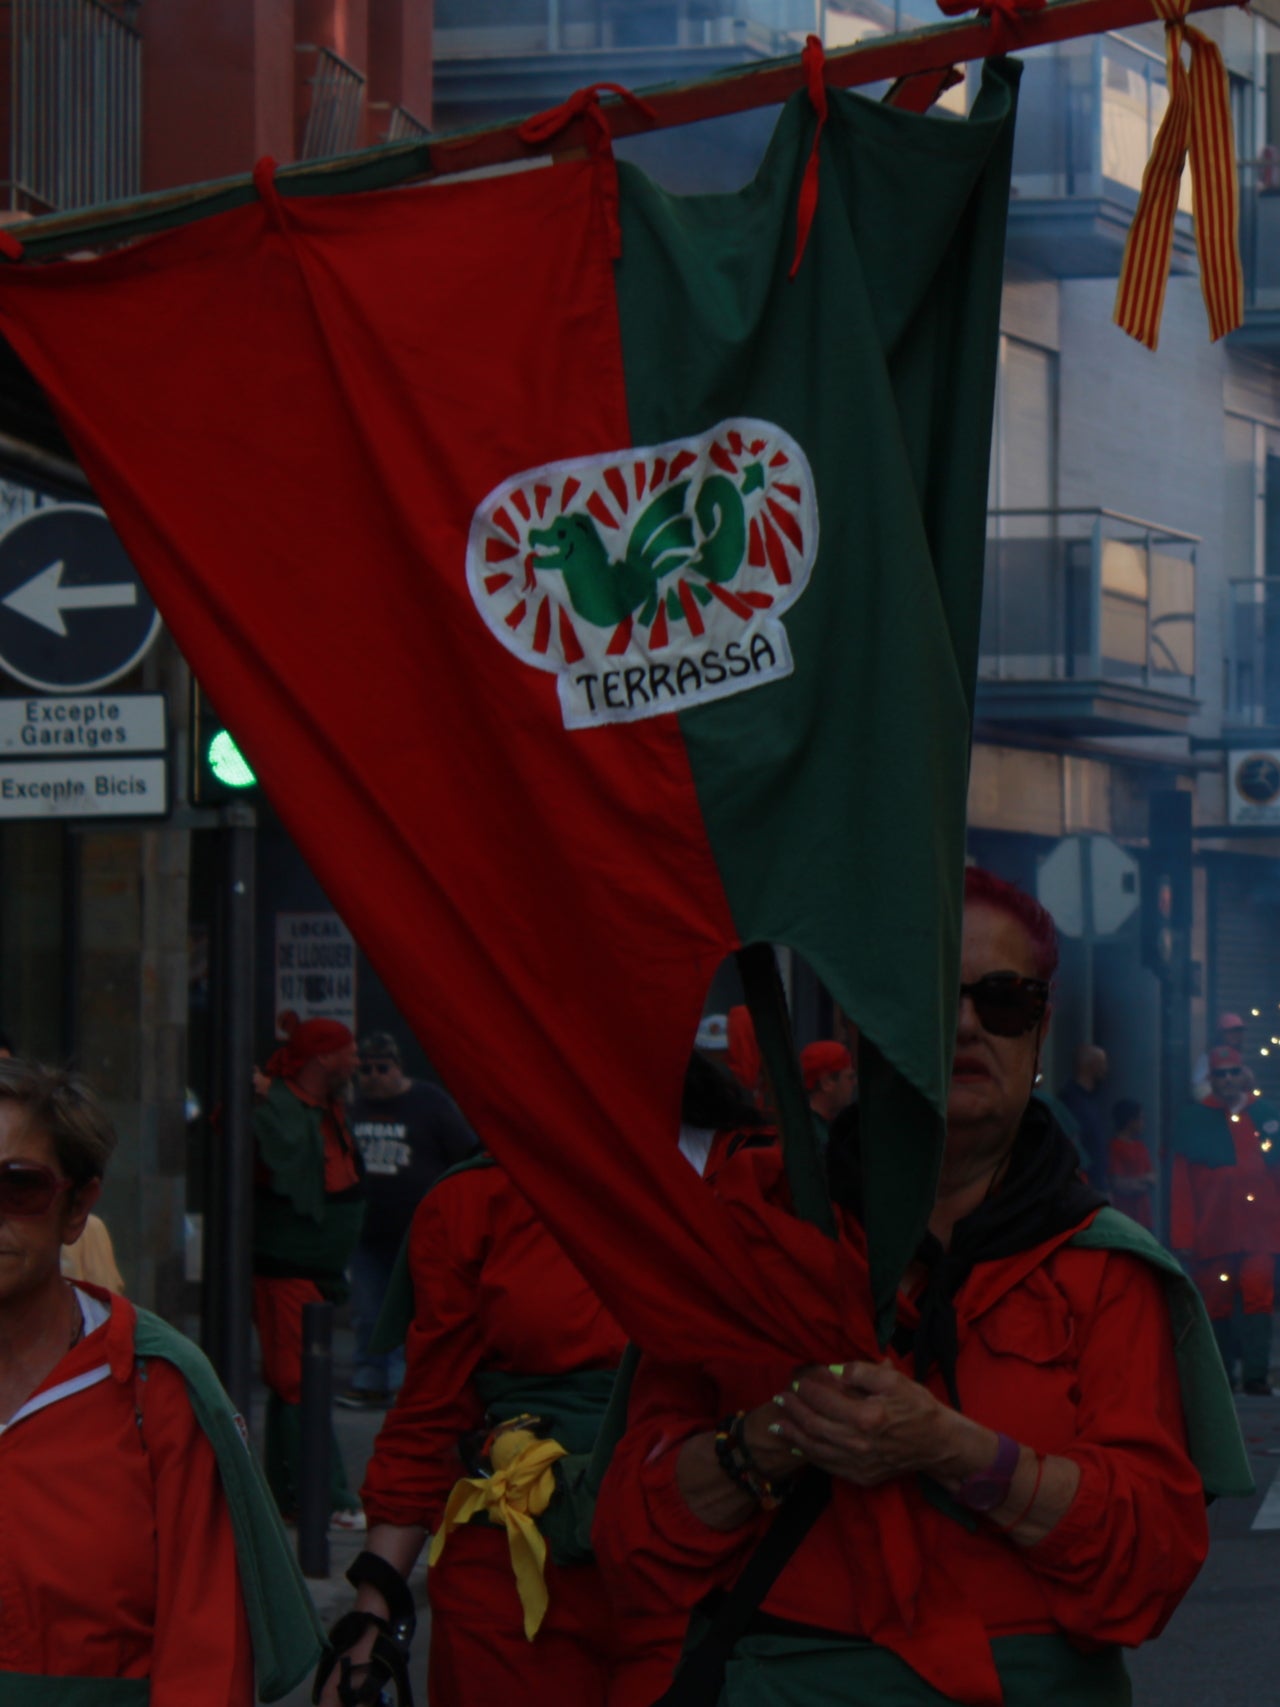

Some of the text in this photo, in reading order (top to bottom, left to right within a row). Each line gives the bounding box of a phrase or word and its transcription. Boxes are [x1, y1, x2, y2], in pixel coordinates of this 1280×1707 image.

[576, 633, 776, 712] TERRASSA
[25, 700, 120, 724] Excepte
[21, 724, 127, 747] Garatges
[1, 774, 147, 801] Excepte Bicis
[354, 1122, 406, 1138] URBAN
